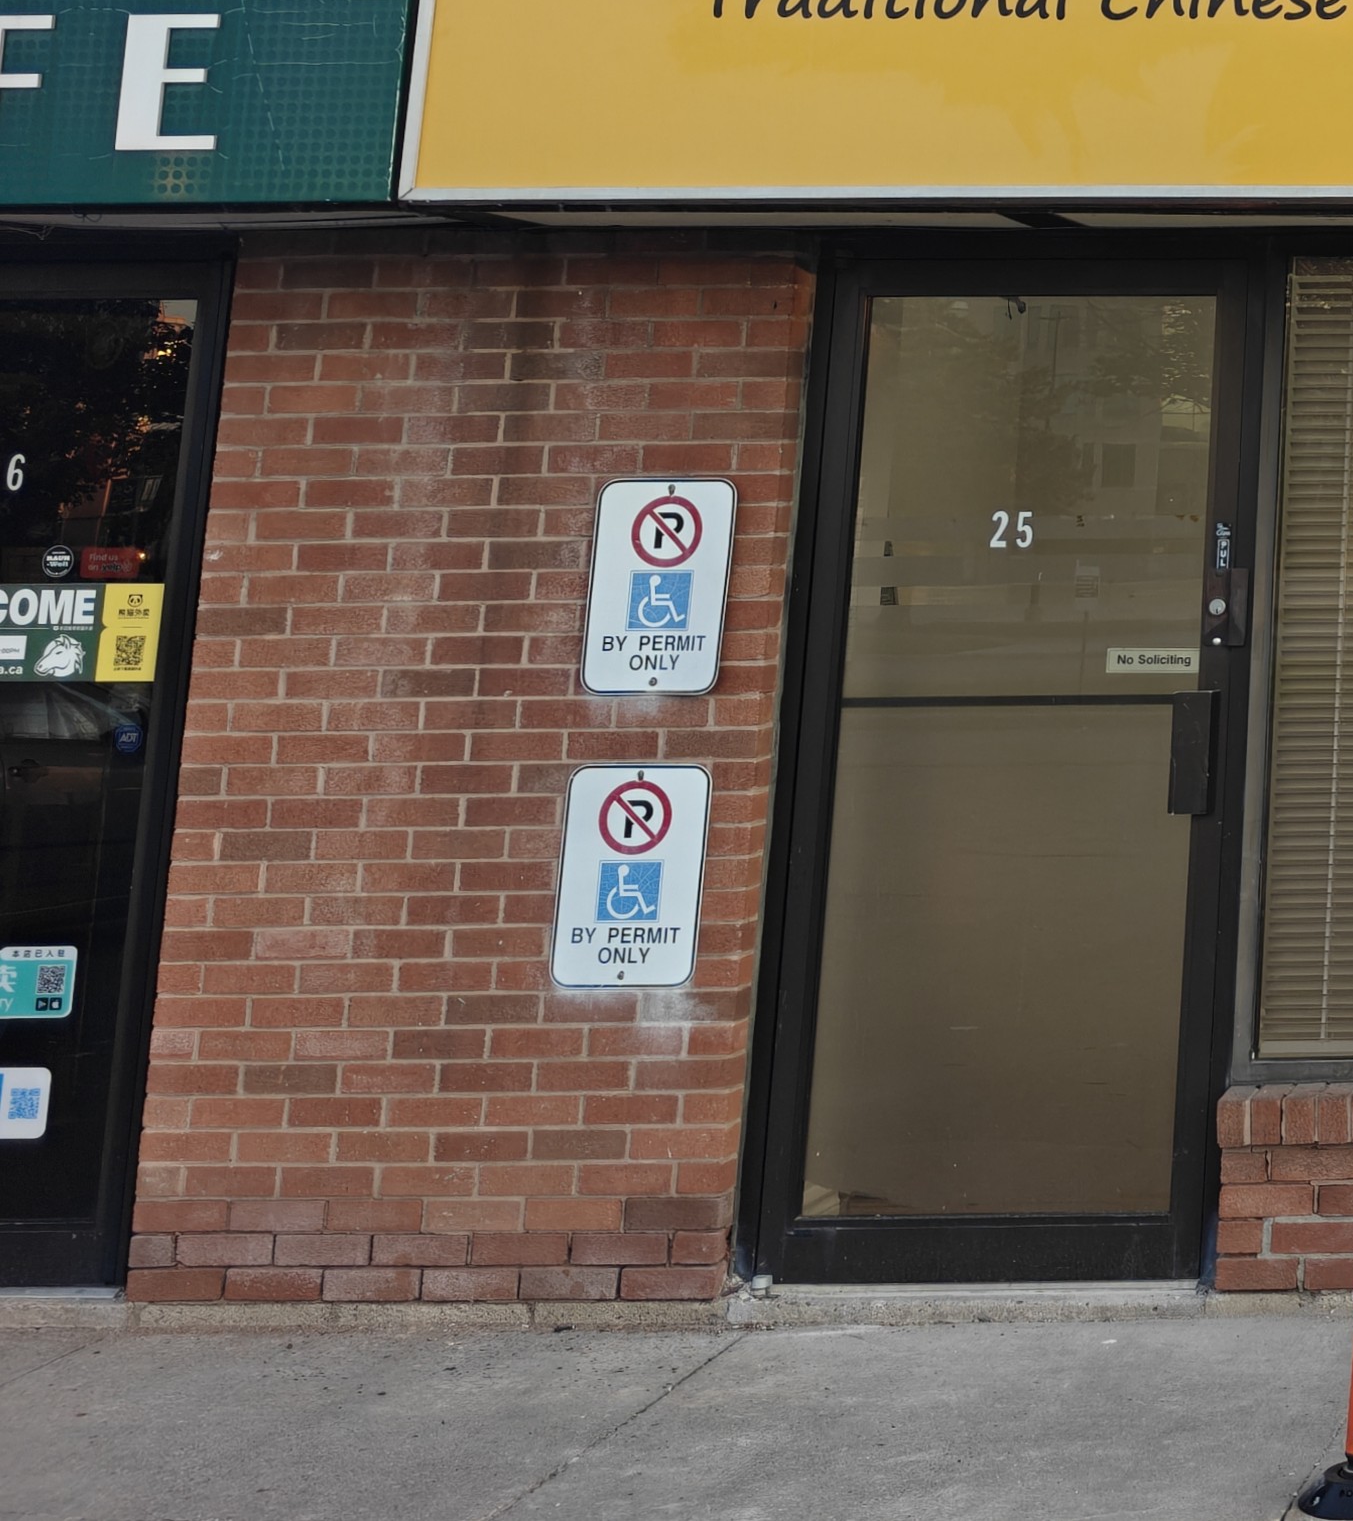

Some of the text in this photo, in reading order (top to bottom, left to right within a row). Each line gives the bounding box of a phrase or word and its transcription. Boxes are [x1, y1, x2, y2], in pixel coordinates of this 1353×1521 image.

[989, 510, 1034, 549] 25
[601, 635, 706, 652] BY PERMIT
[629, 654, 680, 671] ONLY
[1117, 654, 1192, 667] No Soliciting
[571, 927, 681, 944] BY PERMIT
[597, 947, 650, 964] ONLY
